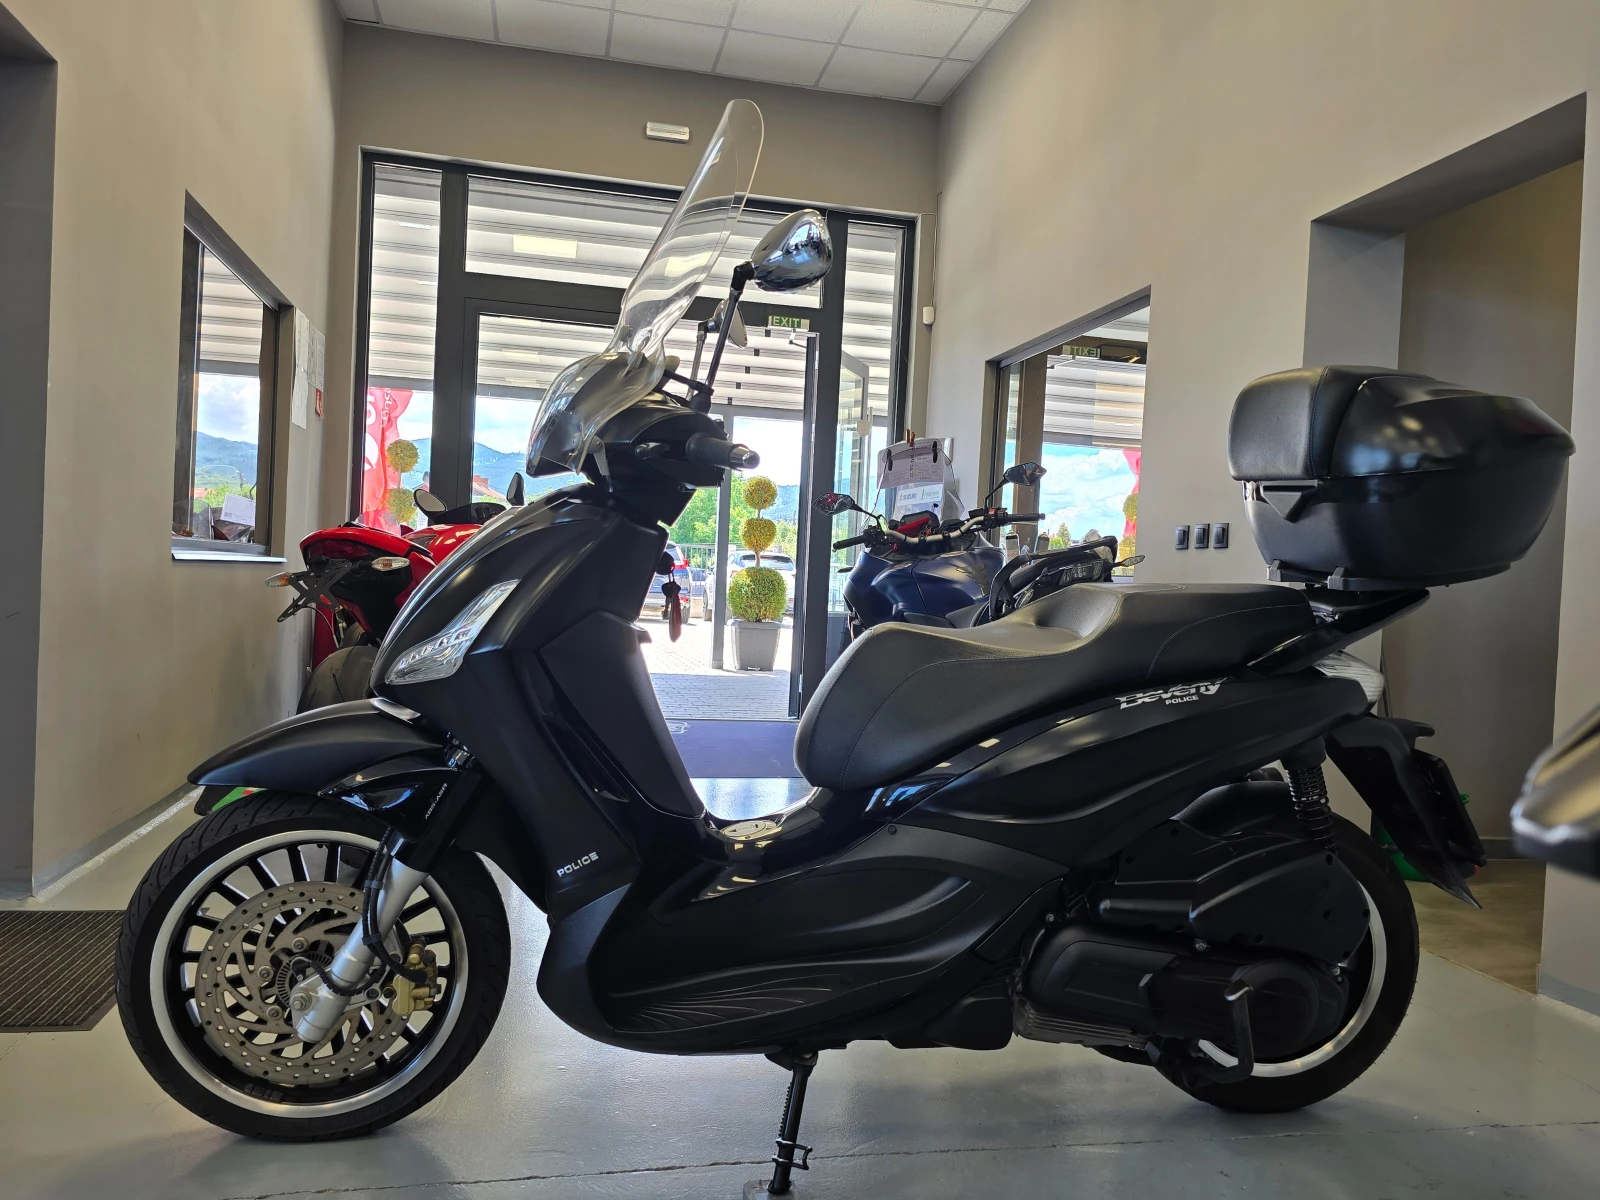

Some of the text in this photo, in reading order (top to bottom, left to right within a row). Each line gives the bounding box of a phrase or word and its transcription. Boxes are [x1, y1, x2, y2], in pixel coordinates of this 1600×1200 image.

[772, 316, 800, 328] EXIT
[1165, 695, 1199, 705] POLICE
[557, 851, 599, 877] POLICE
